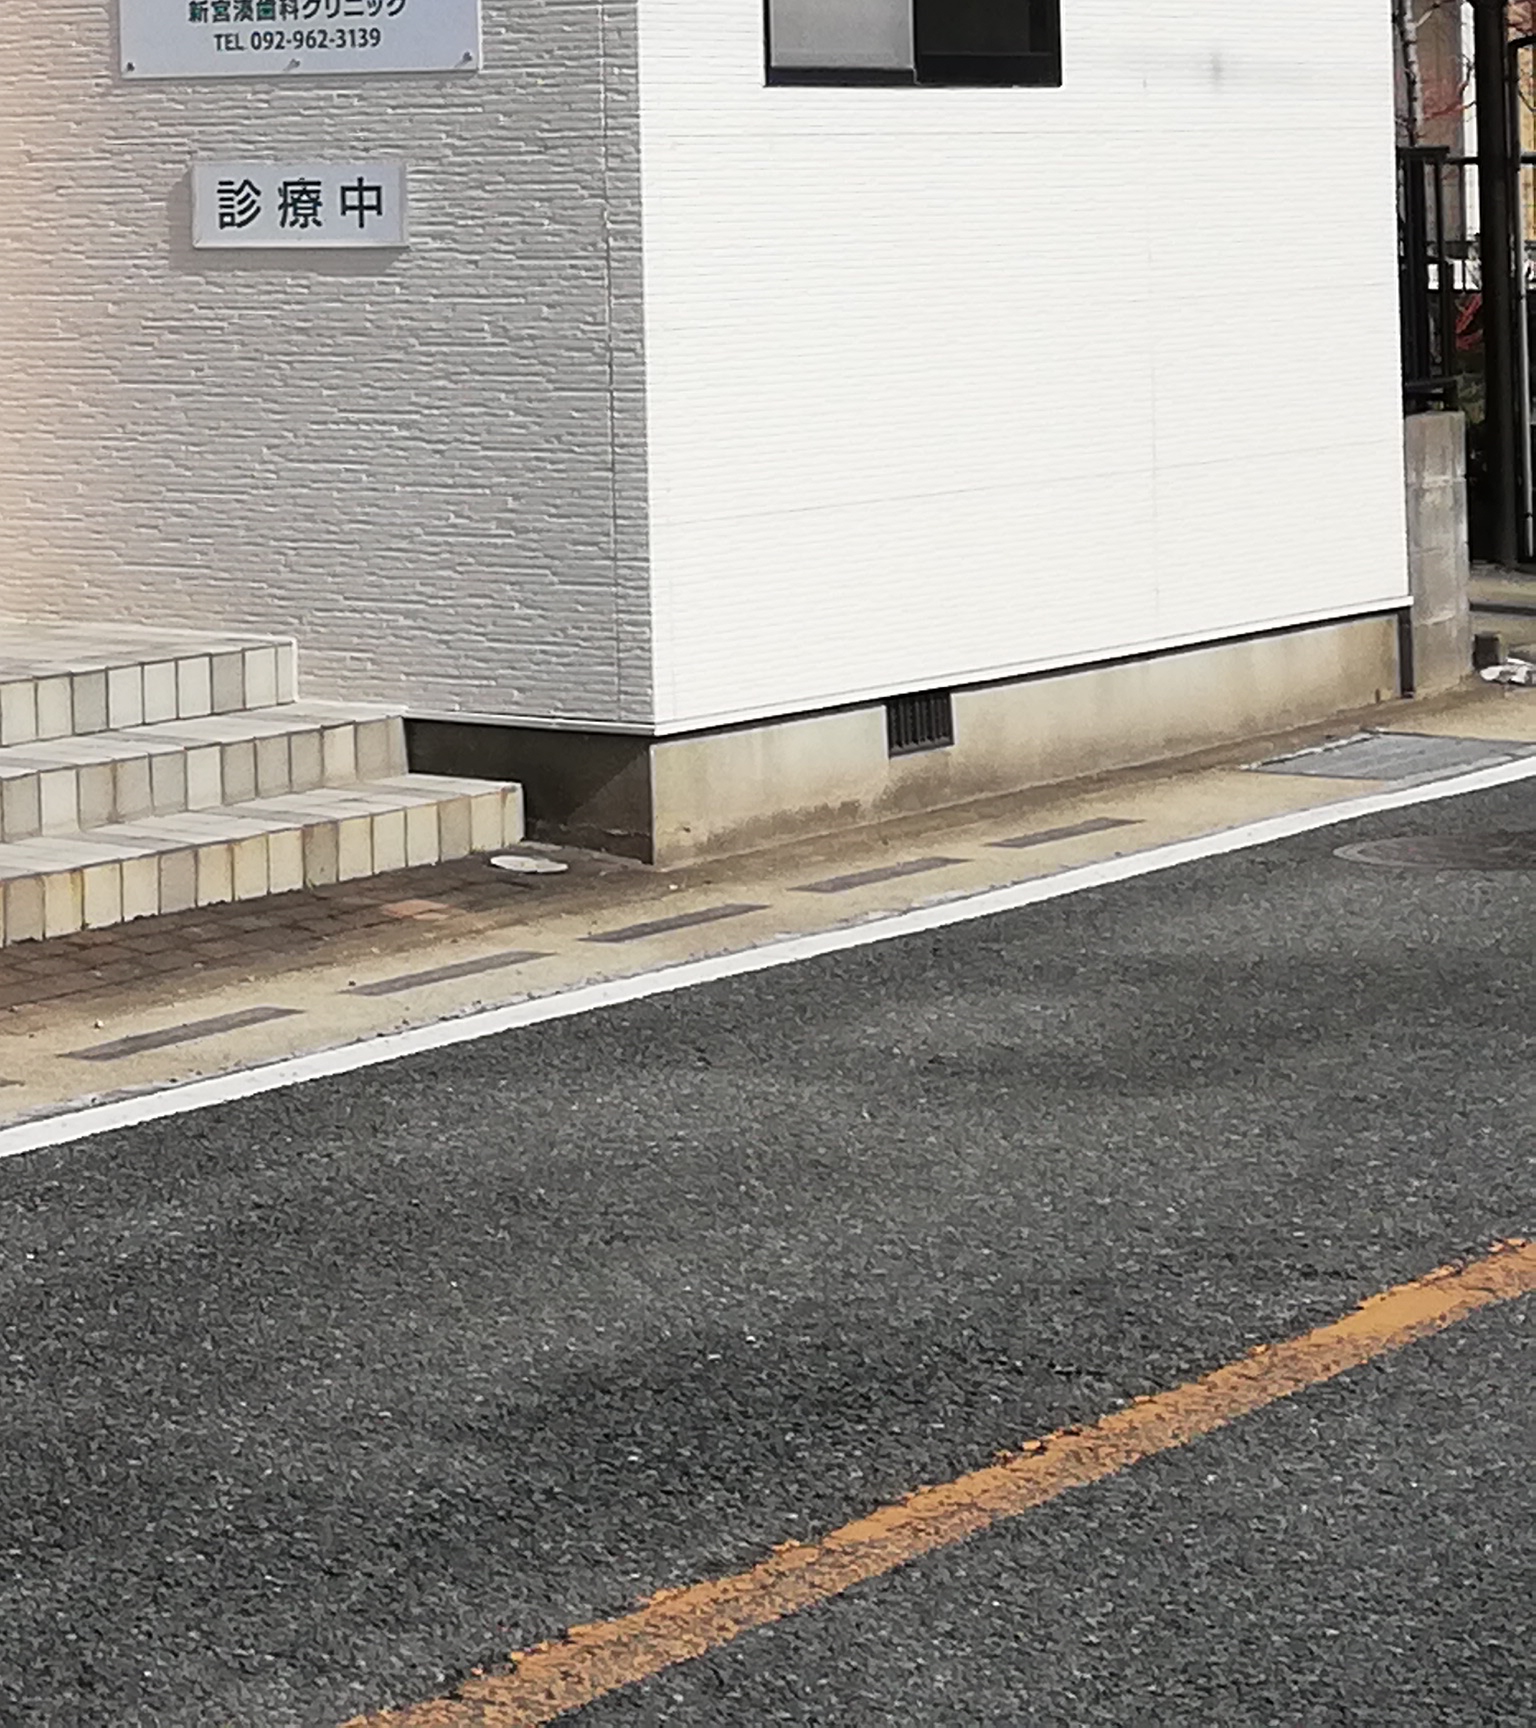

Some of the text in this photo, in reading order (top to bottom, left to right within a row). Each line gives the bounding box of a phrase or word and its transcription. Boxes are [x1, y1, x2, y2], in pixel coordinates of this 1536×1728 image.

[214, 27, 382, 51] TEL 092-962-3139
[216, 176, 384, 230] 診療中
